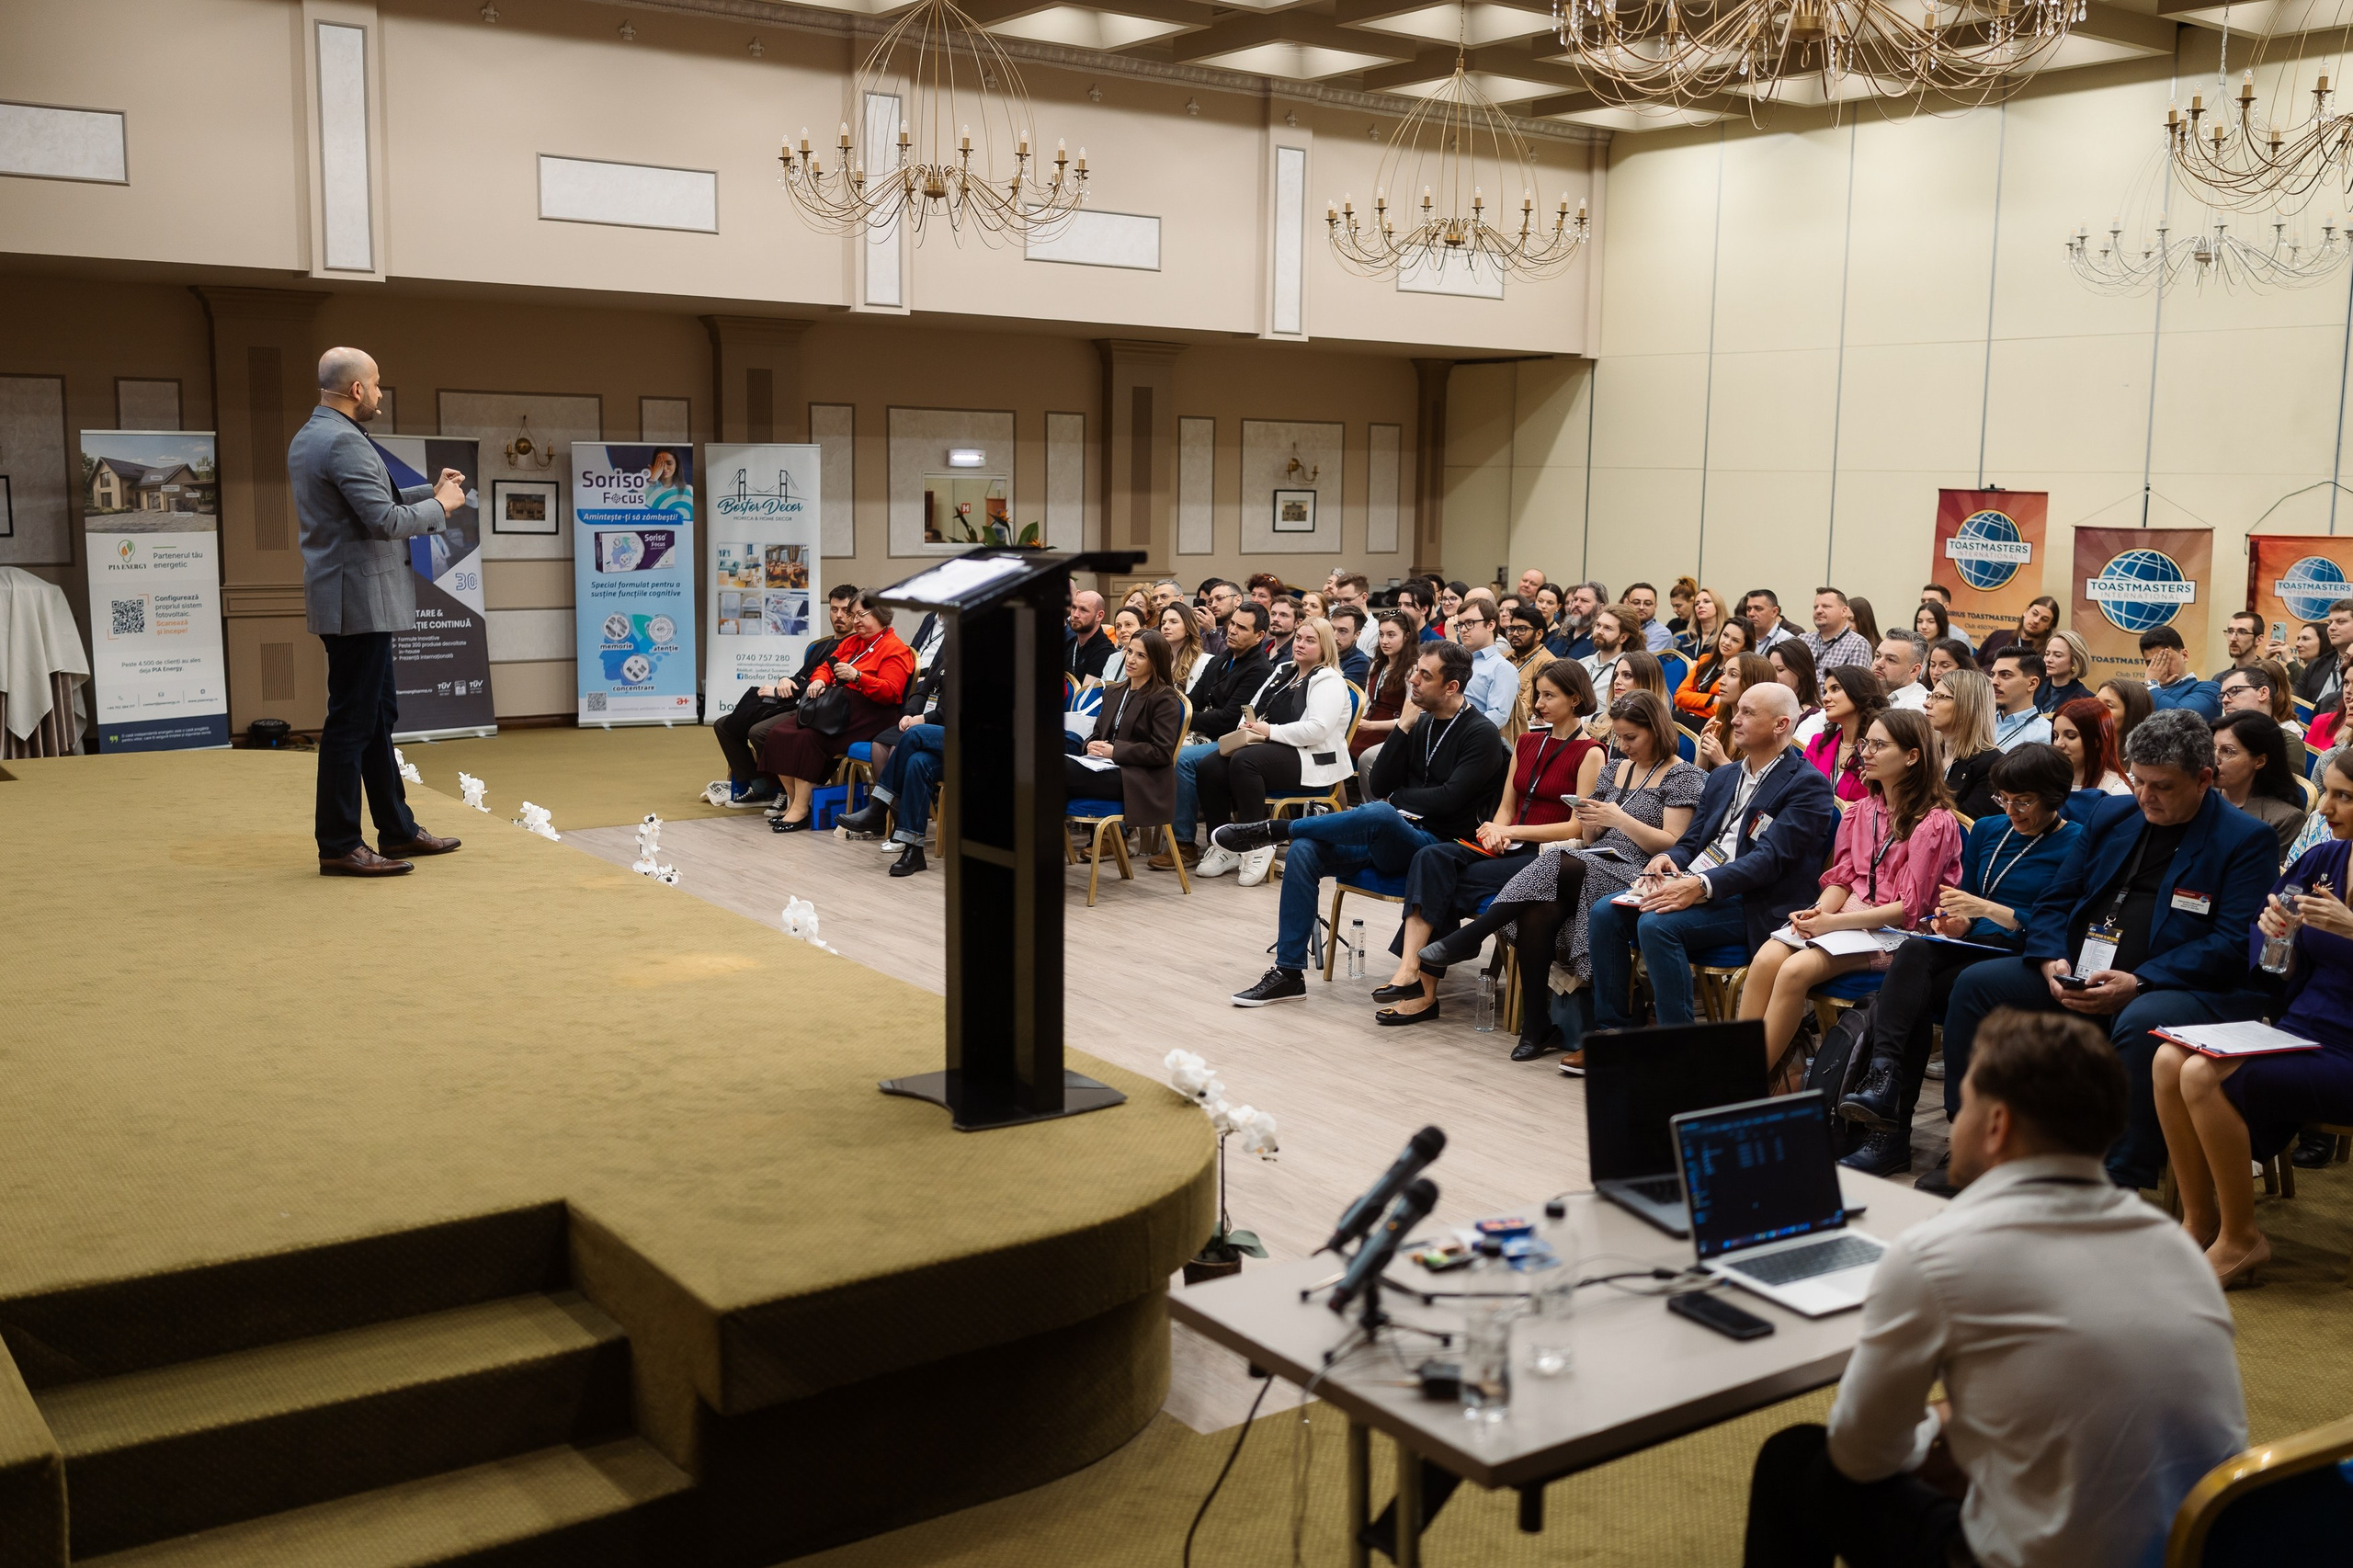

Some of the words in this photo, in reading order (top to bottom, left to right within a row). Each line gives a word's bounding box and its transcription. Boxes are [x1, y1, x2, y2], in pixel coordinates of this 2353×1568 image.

[717, 498, 762, 515] Bosfor
[762, 498, 803, 515] Decor
[1950, 541, 2028, 554] TOASTMASTERS
[1956, 551, 2018, 560] INTERNATIONAL
[591, 581, 617, 590] Special
[618, 581, 650, 590] formulat
[651, 581, 674, 590] pentru
[2090, 582, 2191, 593] TOASTMASTERS
[2278, 582, 2351, 592] TOASTMASTERS
[649, 590, 681, 598] cognitive
[429, 618, 472, 629] CONTINUĂ
[2091, 656, 2147, 665] TOASTMAST
